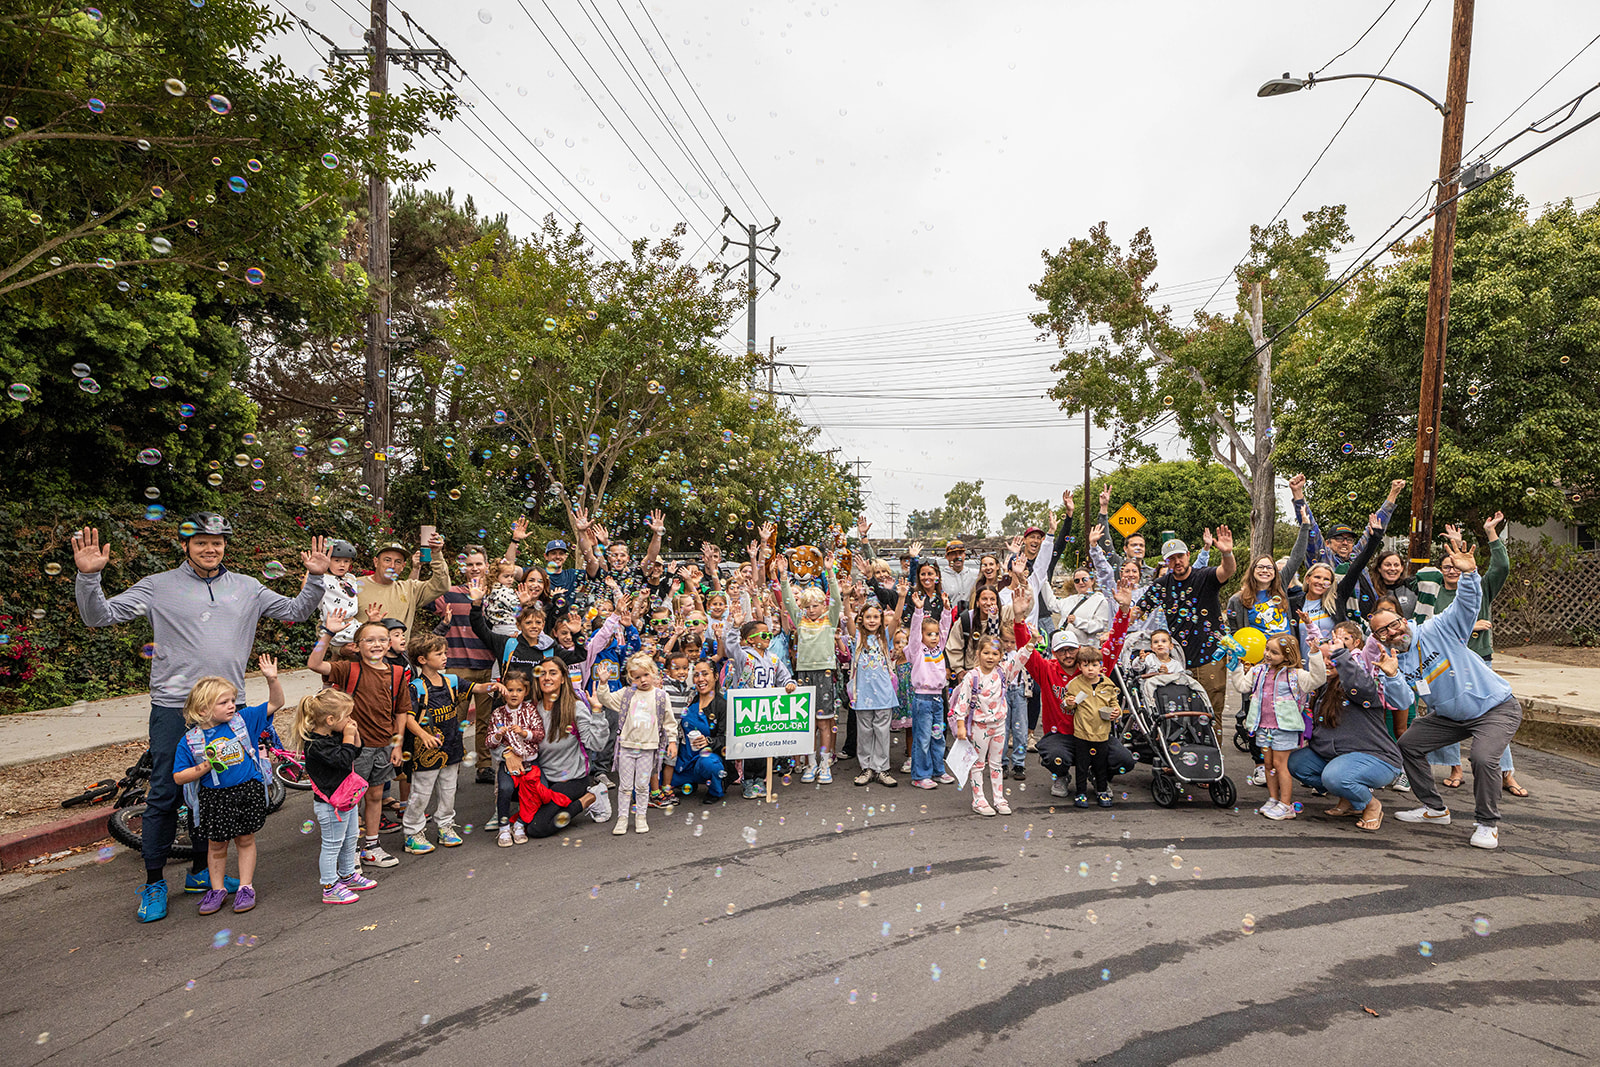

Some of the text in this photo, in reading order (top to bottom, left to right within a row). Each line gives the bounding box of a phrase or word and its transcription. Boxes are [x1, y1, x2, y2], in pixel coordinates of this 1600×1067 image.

[736, 696, 808, 724] WALK
[754, 722, 790, 732] SCHOOL
[792, 722, 808, 730] DAY
